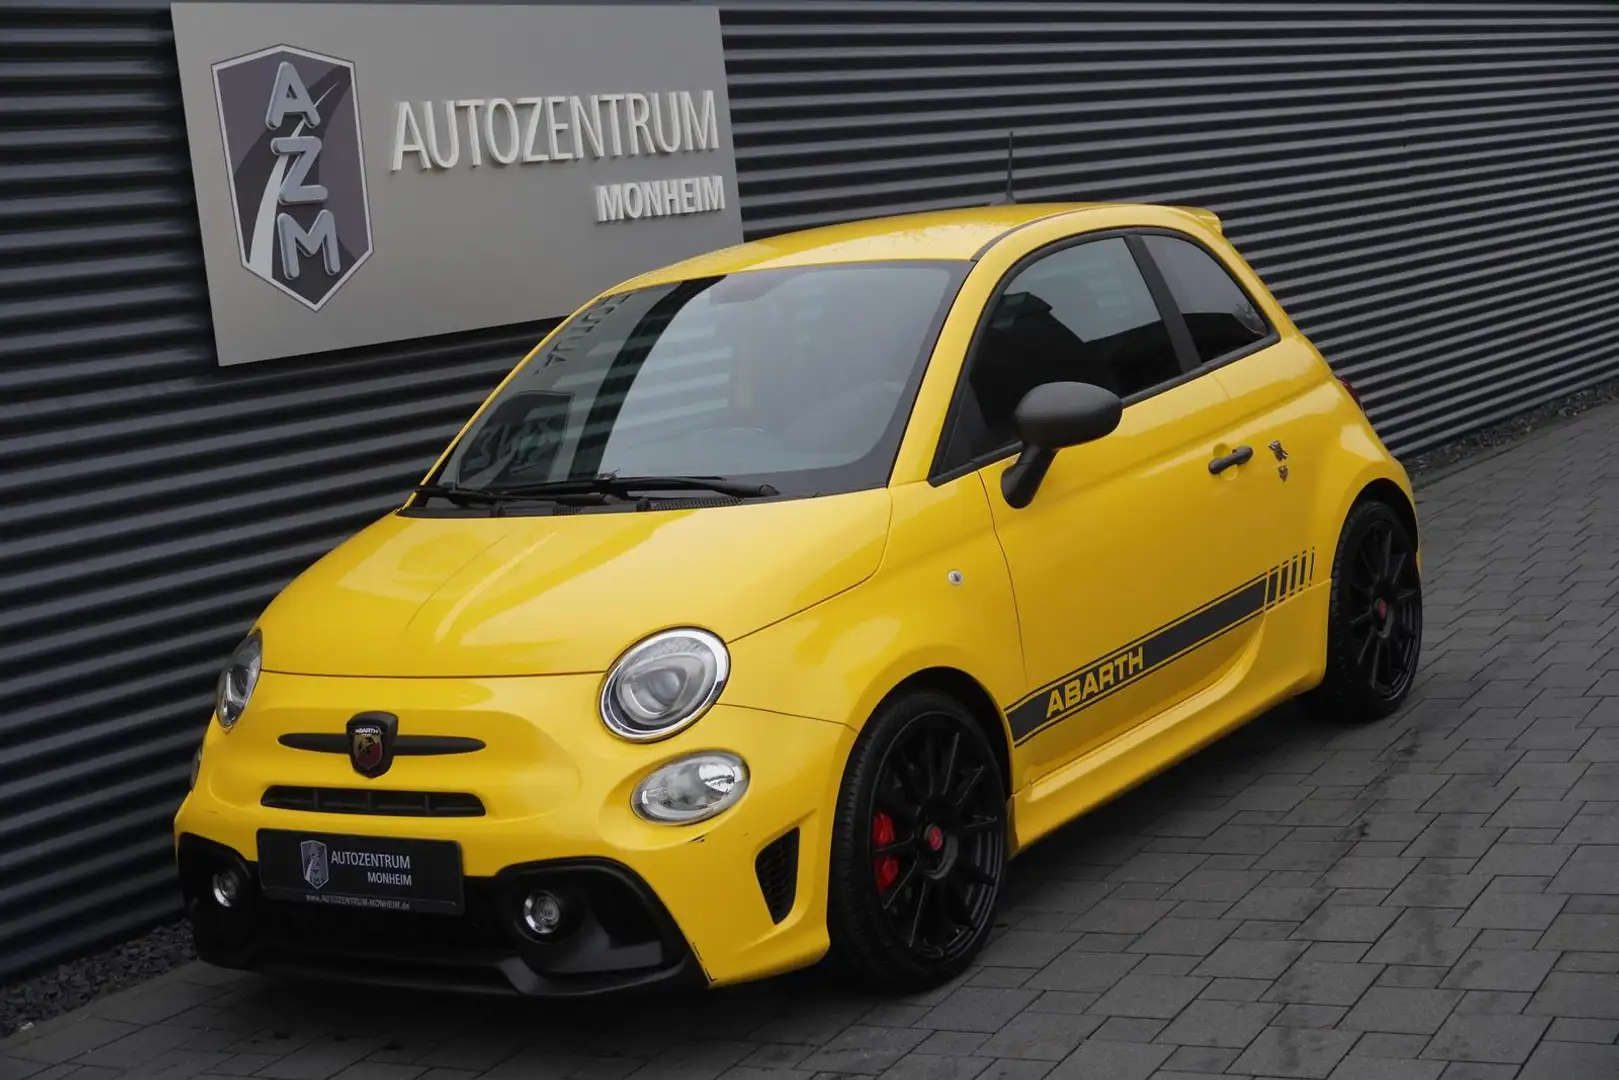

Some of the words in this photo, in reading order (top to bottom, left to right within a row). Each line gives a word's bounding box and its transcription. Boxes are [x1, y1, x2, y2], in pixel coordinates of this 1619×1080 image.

[391, 90, 720, 171] AUTOZENTRUM
[265, 61, 341, 280] AZM
[595, 176, 726, 222] MONHEIM
[1045, 646, 1144, 718] ABARTH
[331, 850, 411, 869] AUTOZENTRUM
[367, 872, 412, 886] MONHEIM
